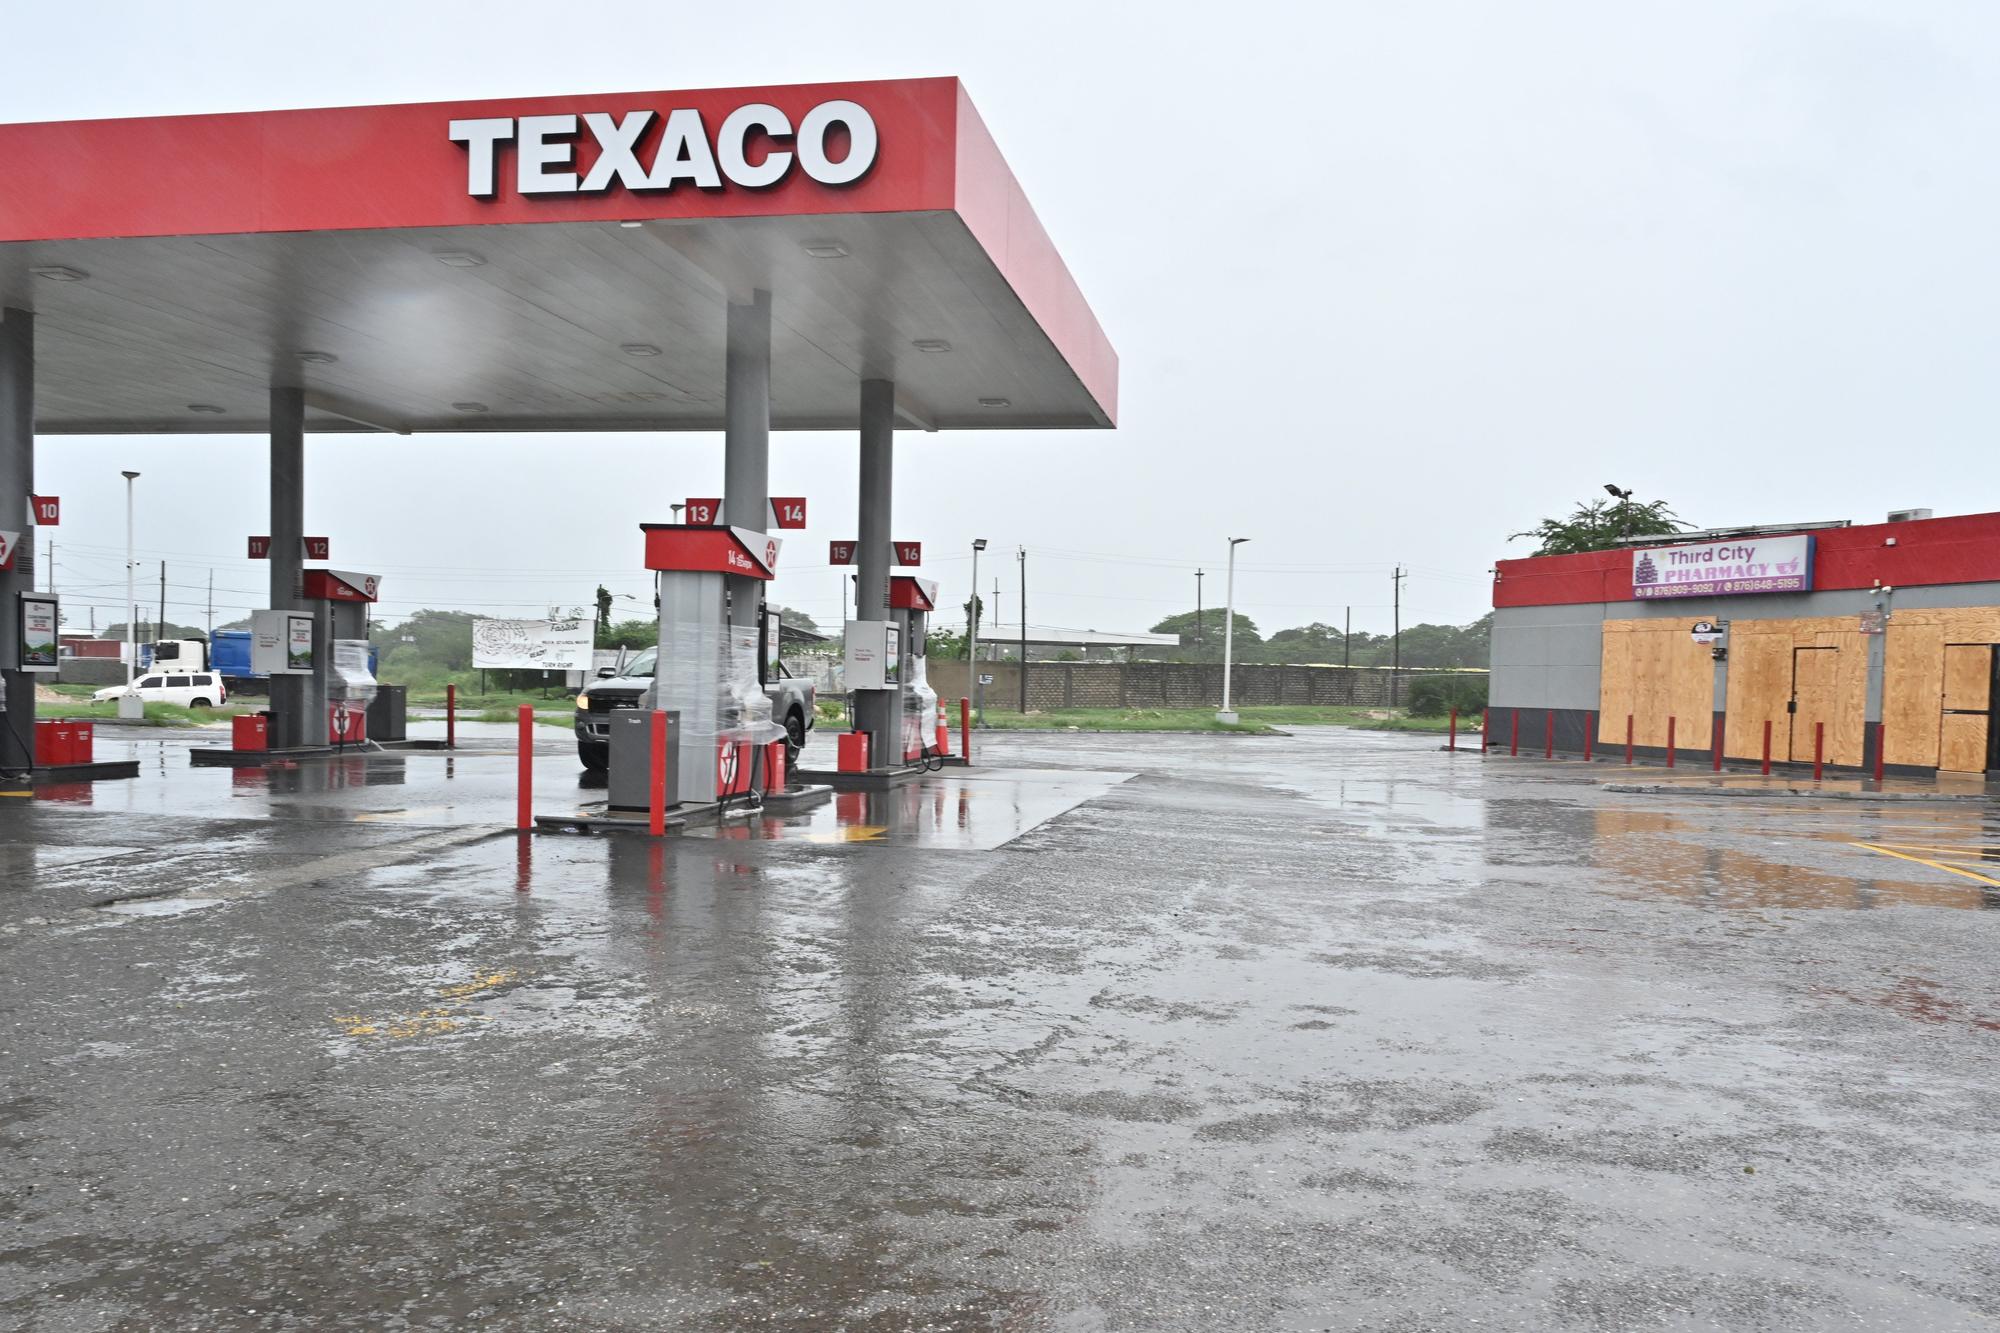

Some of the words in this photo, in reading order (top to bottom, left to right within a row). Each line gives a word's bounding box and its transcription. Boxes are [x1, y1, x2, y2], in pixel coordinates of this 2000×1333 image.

[449, 99, 879, 197] TEXACO
[41, 503, 58, 519] 10
[690, 505, 710, 522] 13
[783, 505, 804, 521] 14
[251, 542, 263, 553] 11
[313, 542, 327, 554] 12
[833, 546, 848, 559] 15
[903, 547, 918, 560] 16
[1669, 548, 1713, 565] Third
[1718, 546, 1756, 563] City
[1664, 562, 1770, 583] PHARMACY
